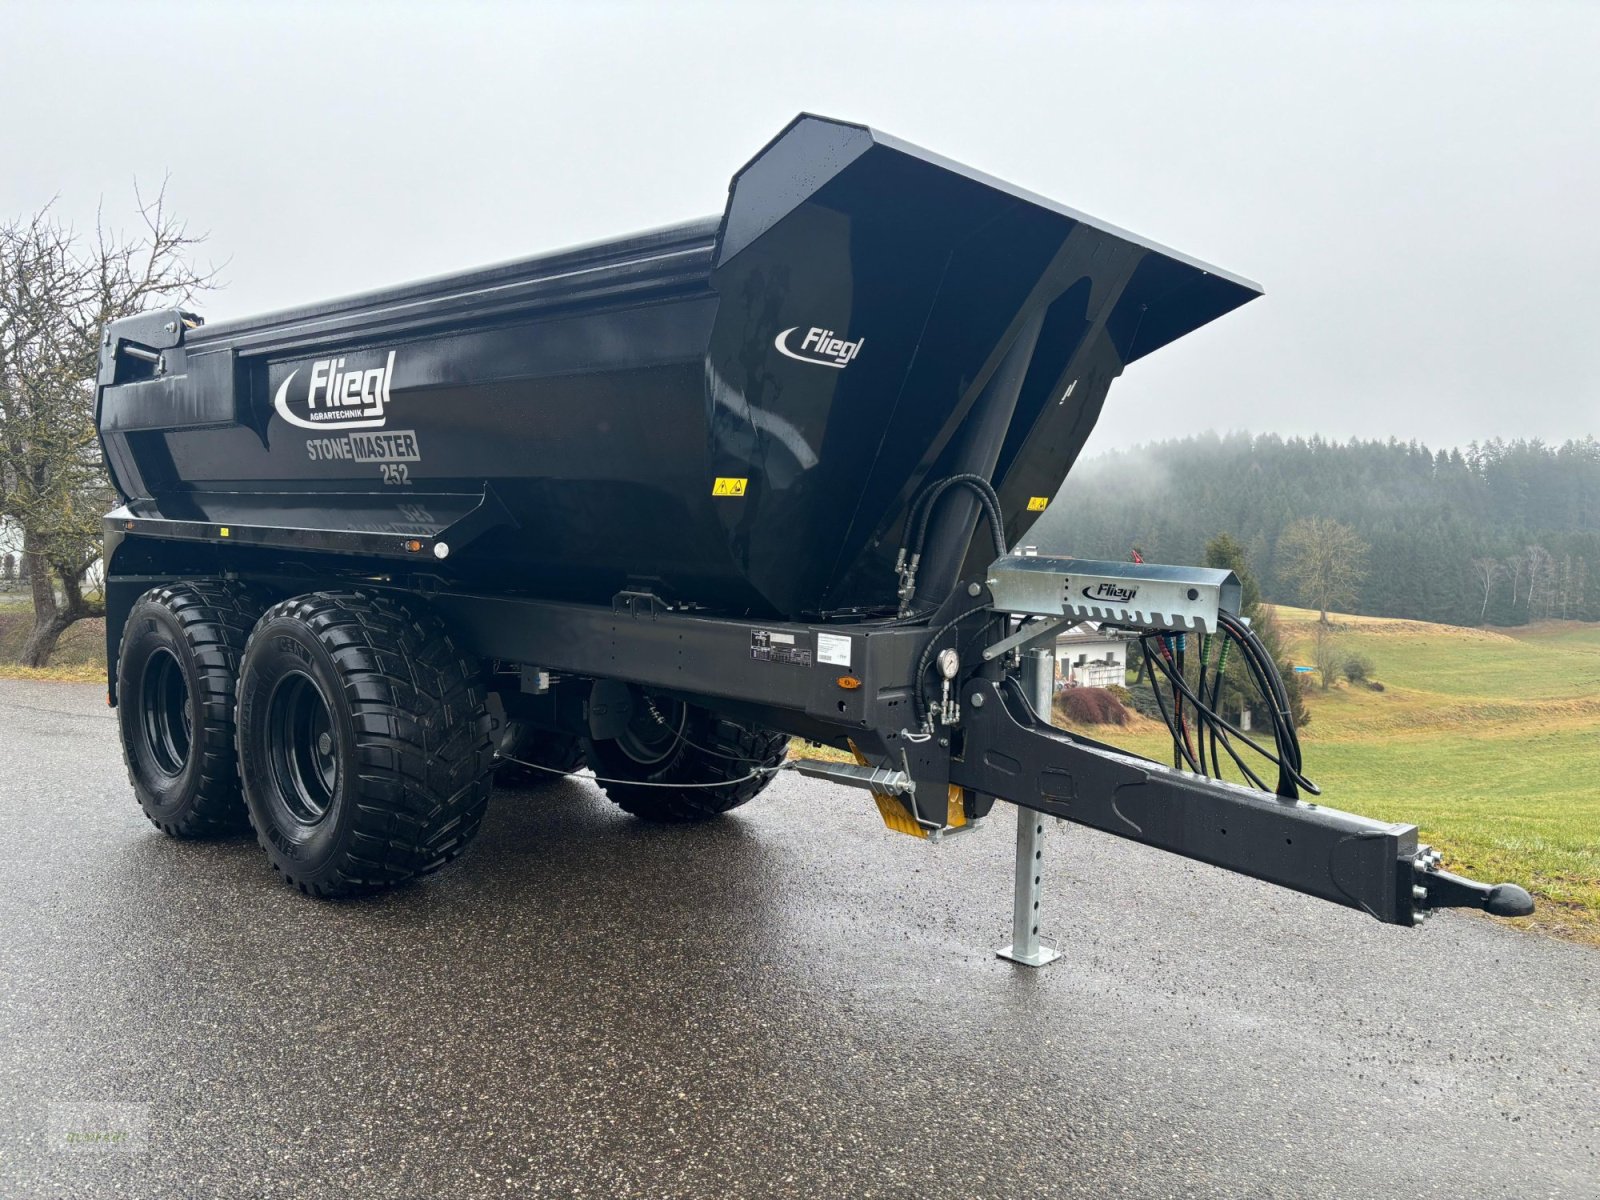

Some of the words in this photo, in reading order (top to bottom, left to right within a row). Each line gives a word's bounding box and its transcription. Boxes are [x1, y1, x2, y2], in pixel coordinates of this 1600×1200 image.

[801, 327, 865, 364] Fliegl
[308, 350, 396, 417] Fliegl
[310, 409, 363, 421] AGRARTECHNIK
[379, 464, 412, 485] 252
[1097, 583, 1139, 601] Fliegl
